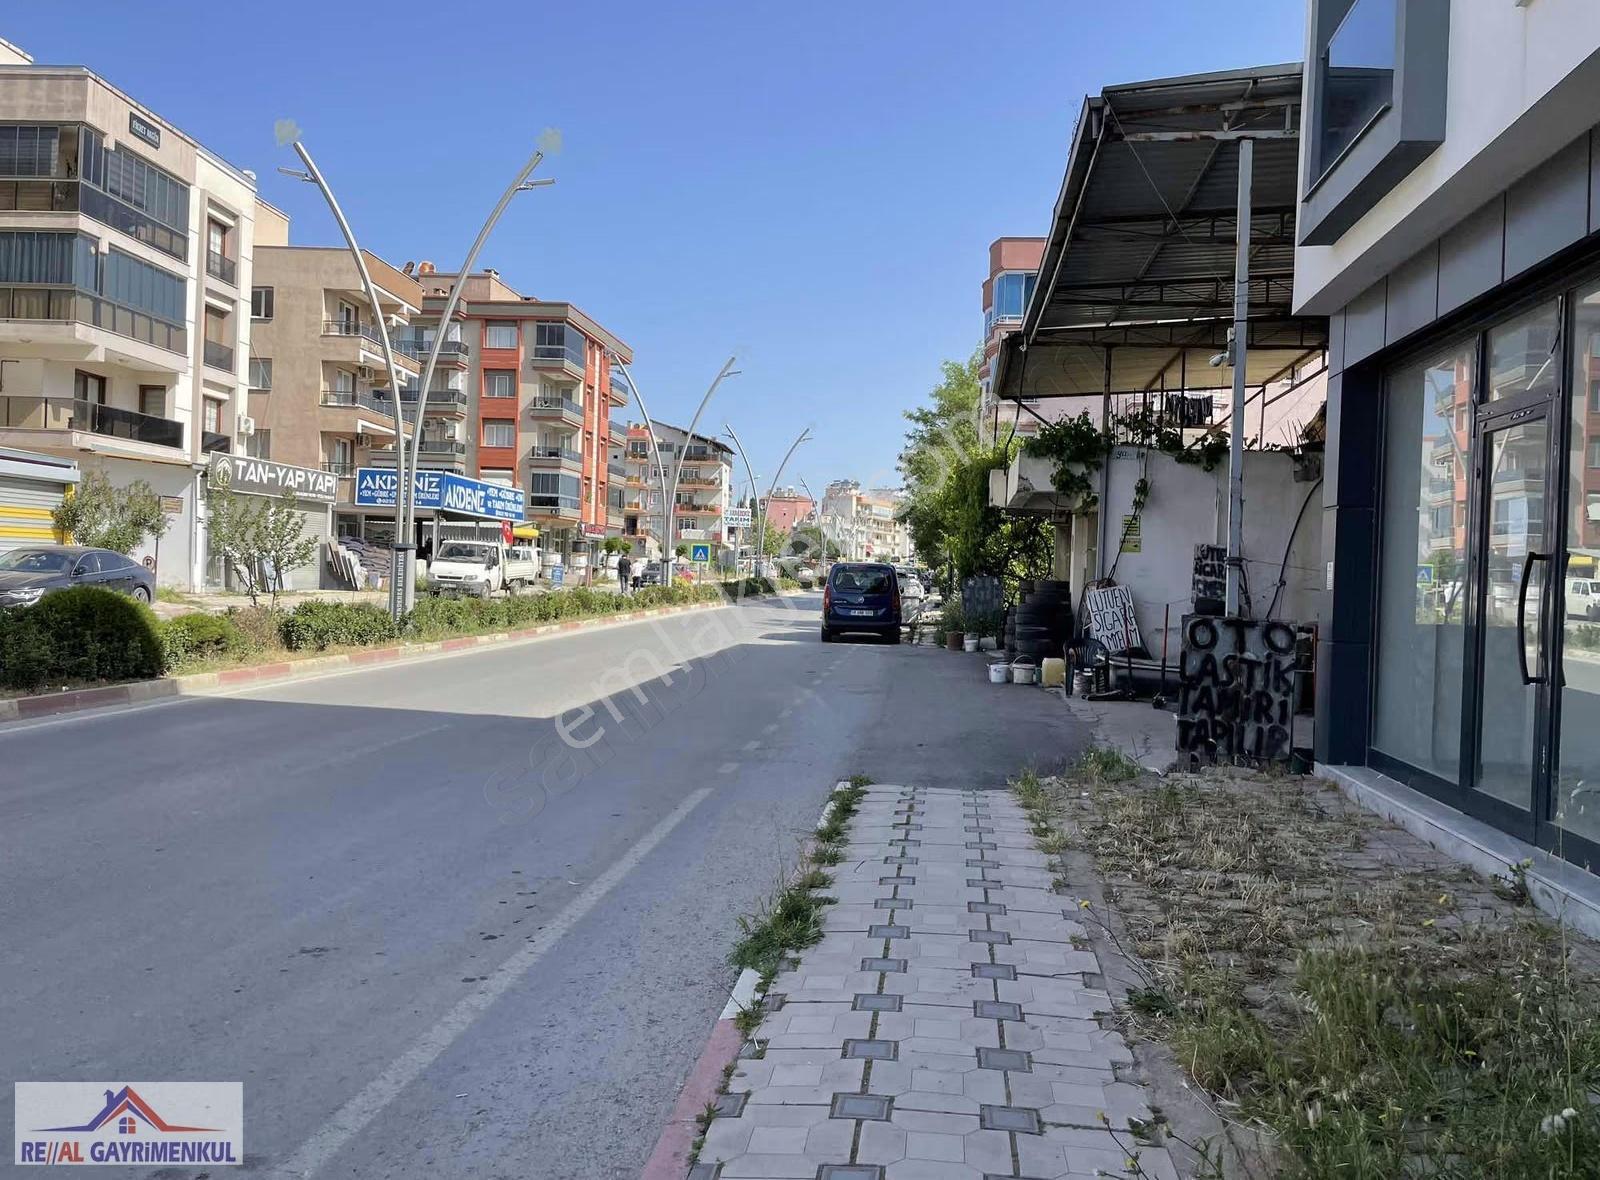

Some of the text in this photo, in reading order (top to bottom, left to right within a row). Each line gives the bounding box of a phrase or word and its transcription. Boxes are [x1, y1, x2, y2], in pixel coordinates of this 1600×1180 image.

[235, 459, 337, 494] TAN-YAP YAPI
[360, 473, 441, 492] AKDNİZ
[444, 483, 486, 513] AKDENİZ
[1188, 618, 1297, 655] OTO
